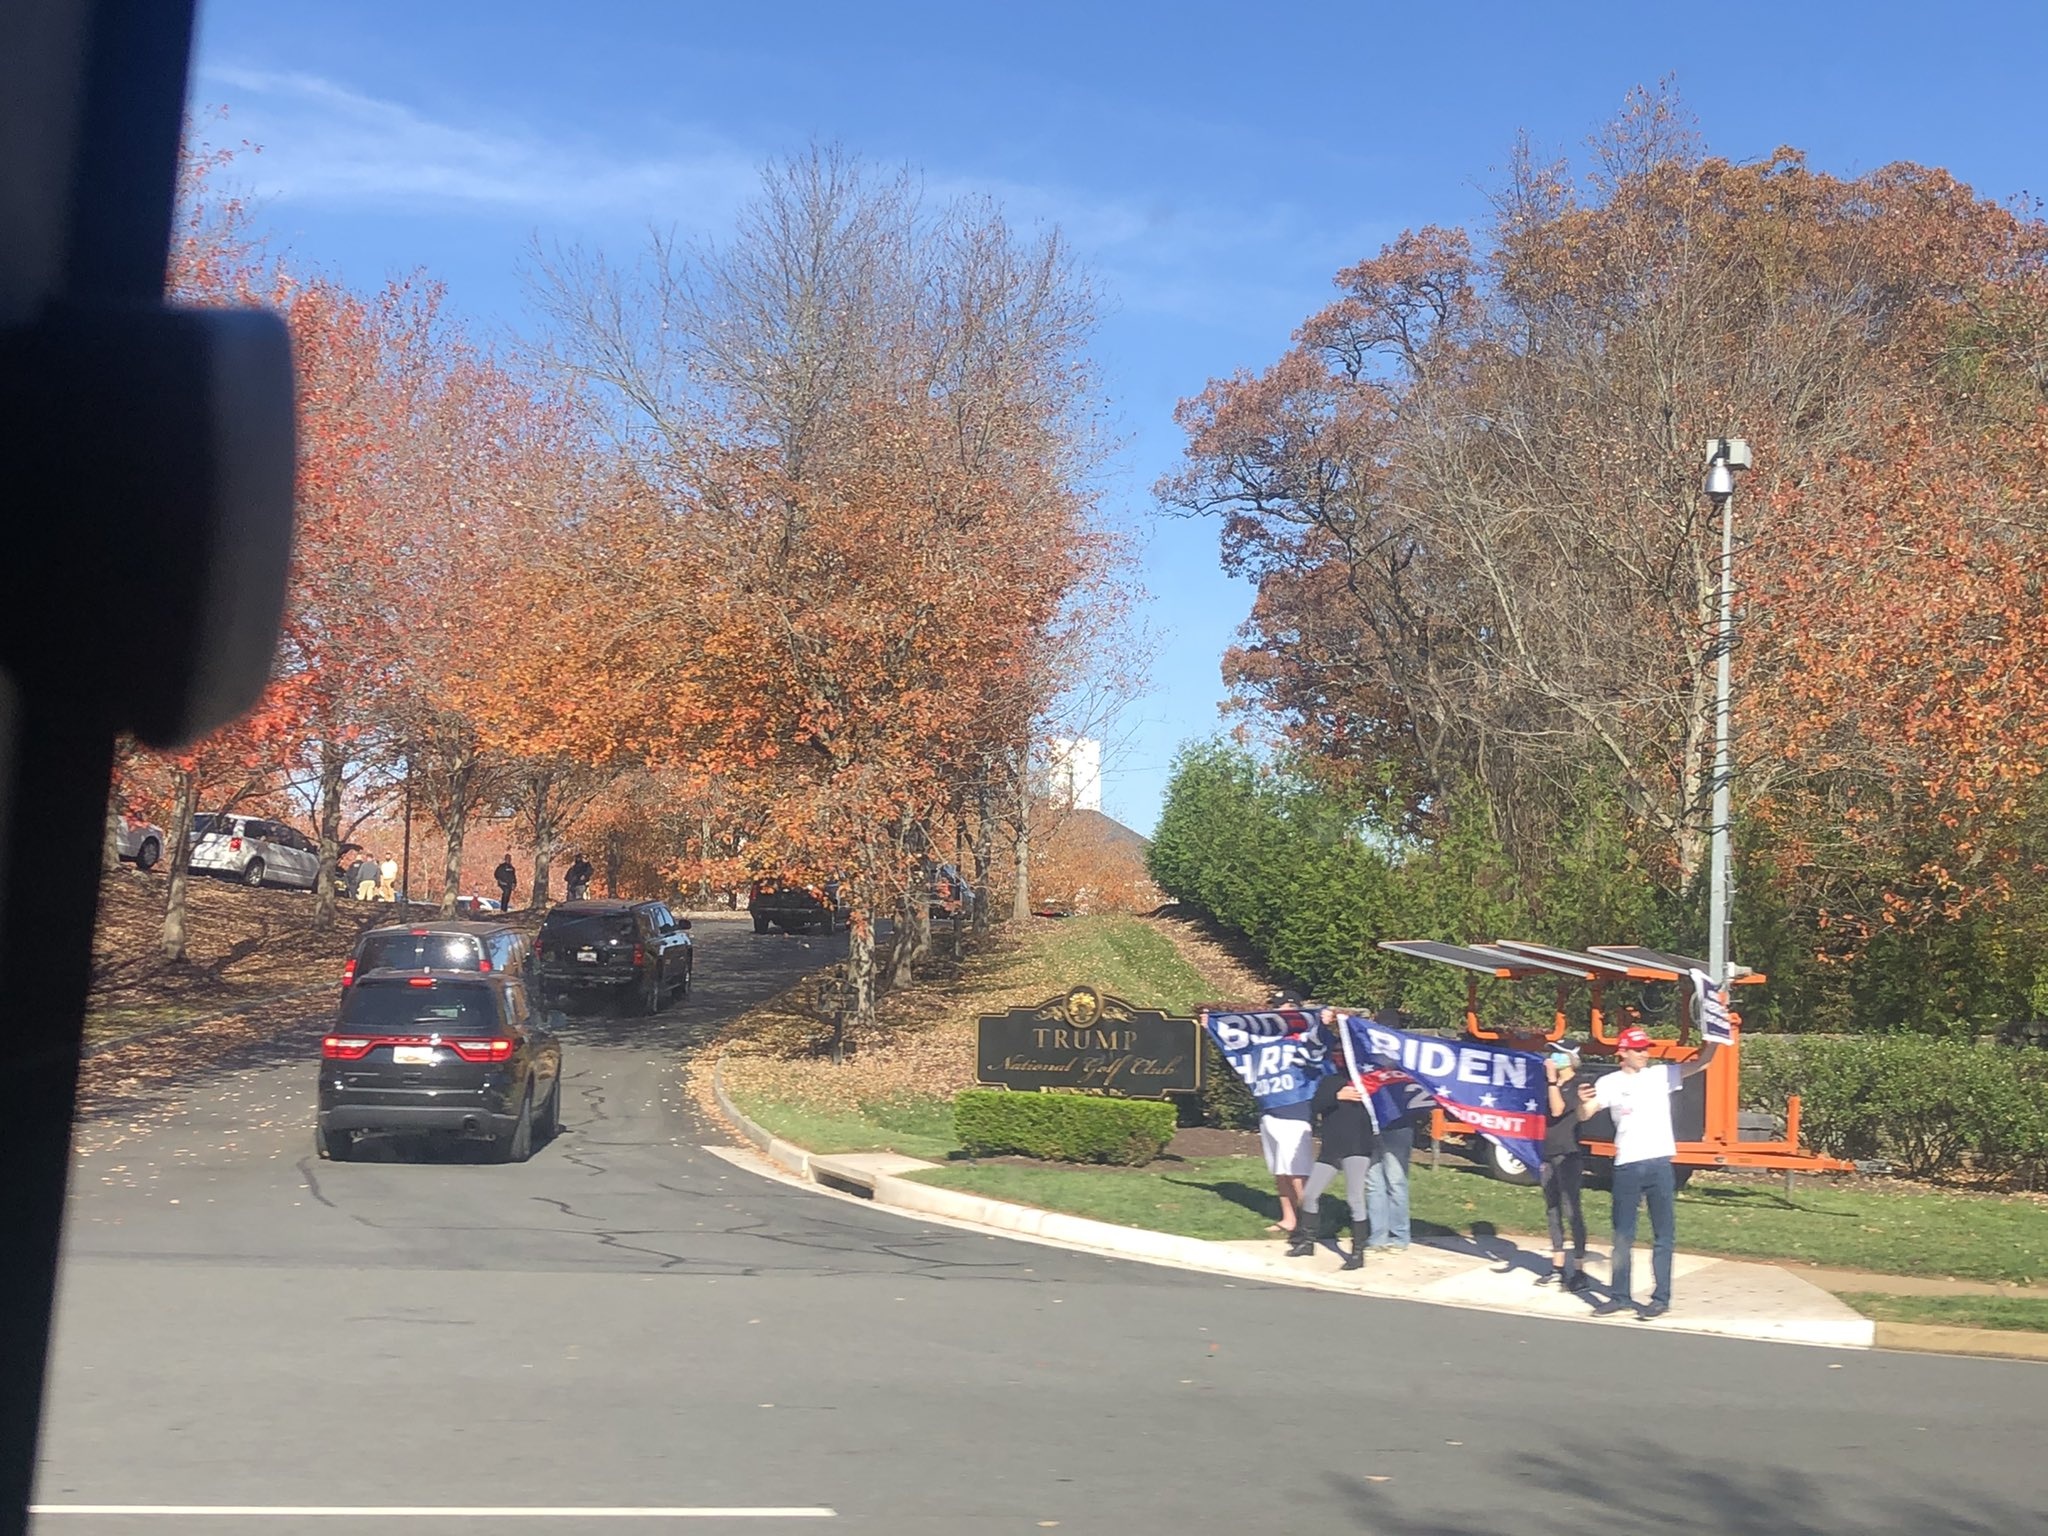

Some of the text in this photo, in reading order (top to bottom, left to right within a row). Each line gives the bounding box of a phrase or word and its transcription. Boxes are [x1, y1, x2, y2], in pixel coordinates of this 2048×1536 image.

[1033, 1028, 1138, 1051] TRUMP
[987, 1054, 1184, 1086] National Golf Club
[1367, 1028, 1528, 1089] BIDEN
